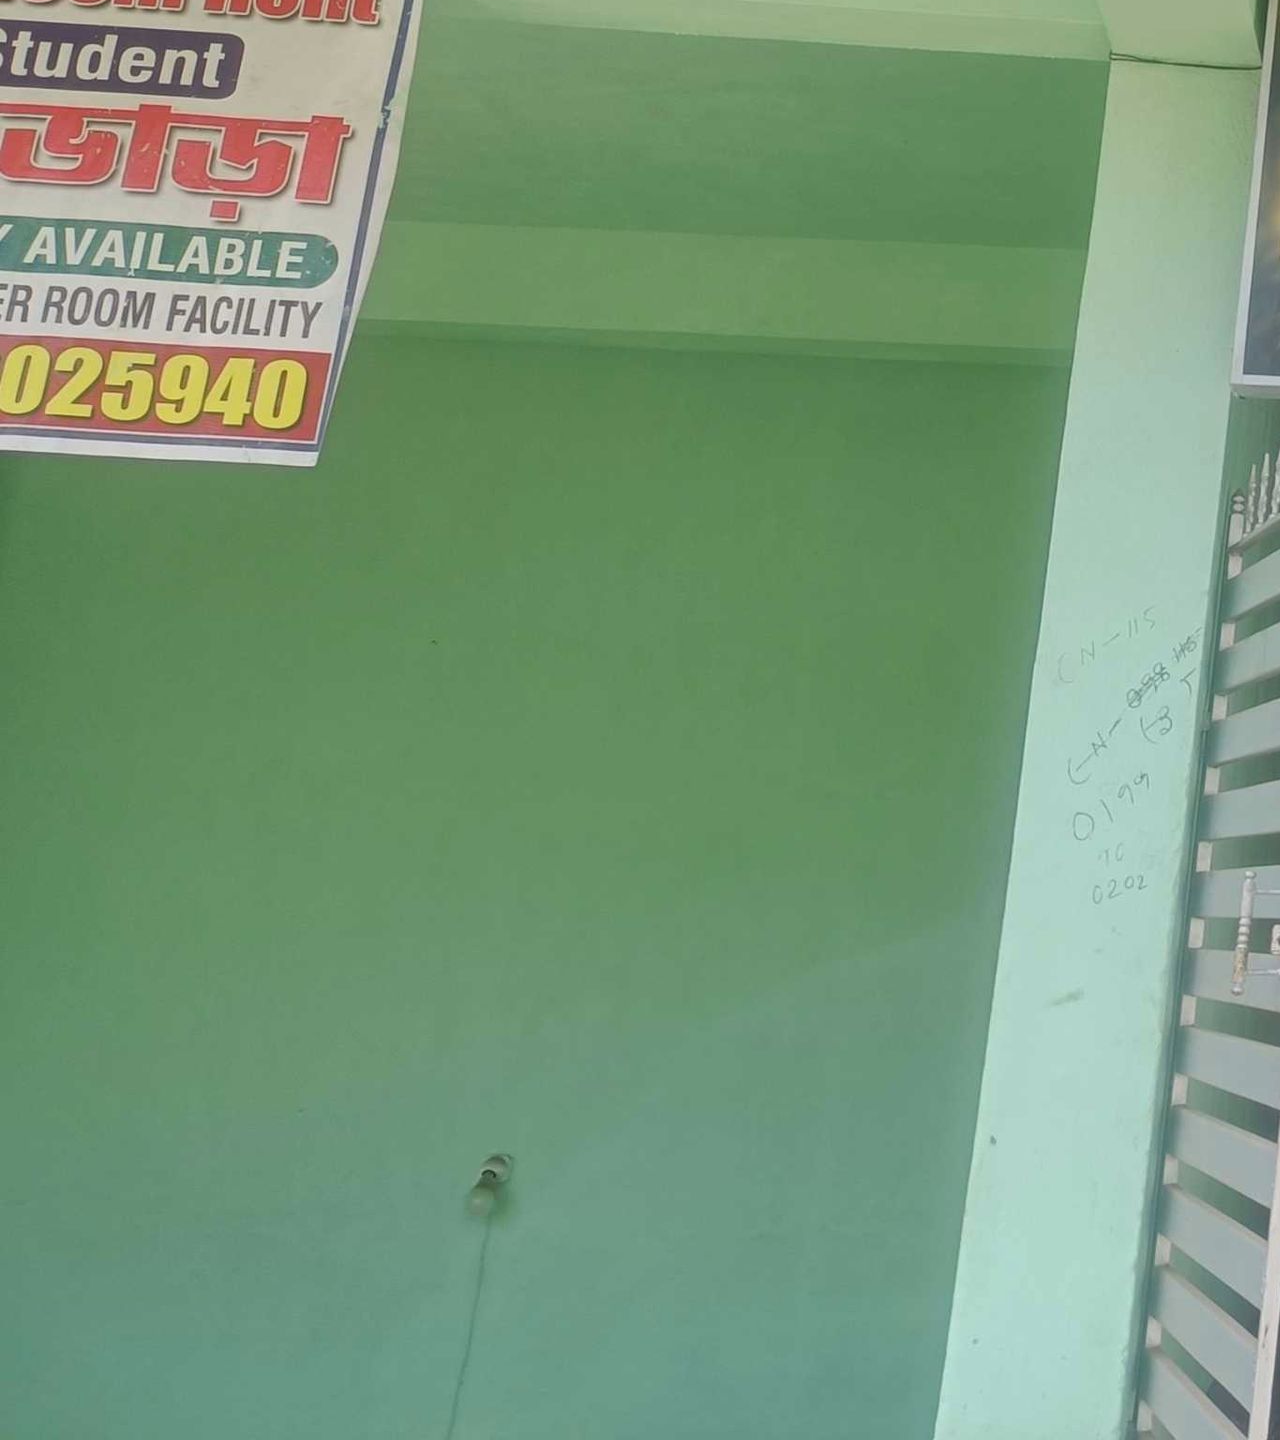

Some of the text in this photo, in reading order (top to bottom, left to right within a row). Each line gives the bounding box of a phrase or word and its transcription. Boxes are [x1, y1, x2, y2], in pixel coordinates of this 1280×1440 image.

[0, 27, 226, 90] tudent
[24, 225, 308, 279] AVAILABLE
[42, 287, 156, 331] ROOM
[165, 294, 323, 339] FACILITY
